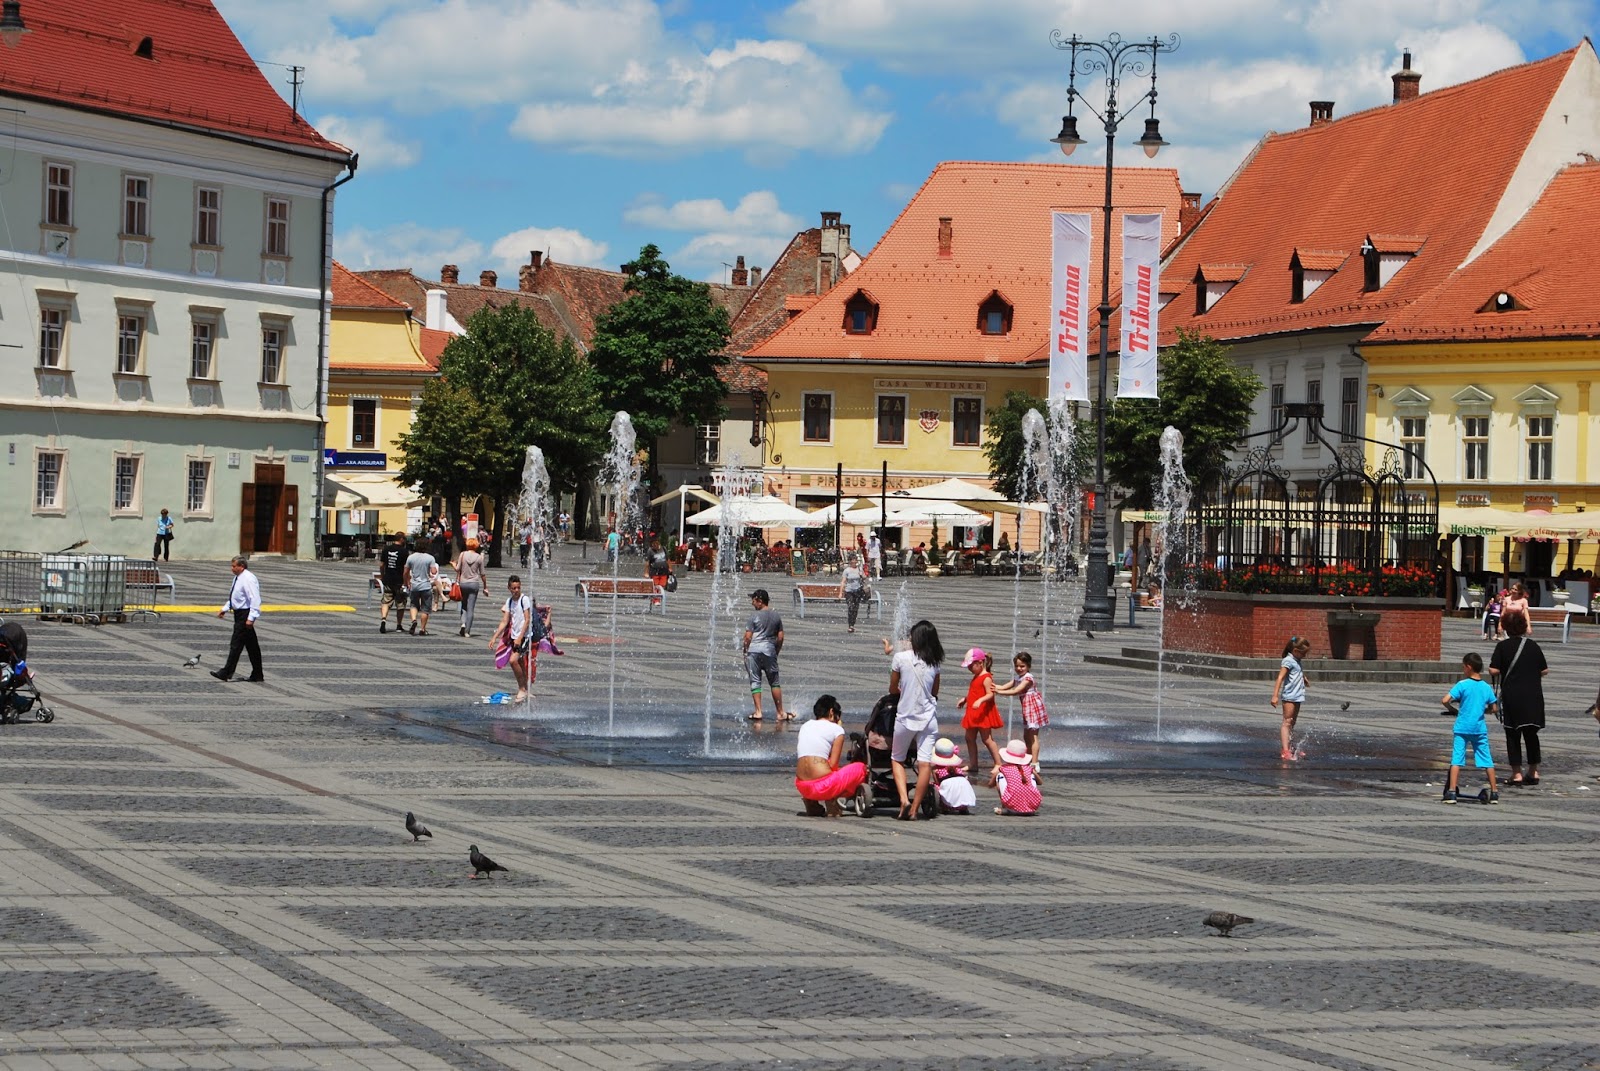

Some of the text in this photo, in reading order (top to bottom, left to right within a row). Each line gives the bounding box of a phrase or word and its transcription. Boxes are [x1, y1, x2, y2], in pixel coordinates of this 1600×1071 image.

[1058, 264, 1081, 354] Tribuna
[1128, 264, 1152, 353] Tribuna
[878, 380, 982, 390] CASA WEIDNER
[1451, 524, 1497, 535] Heineken
